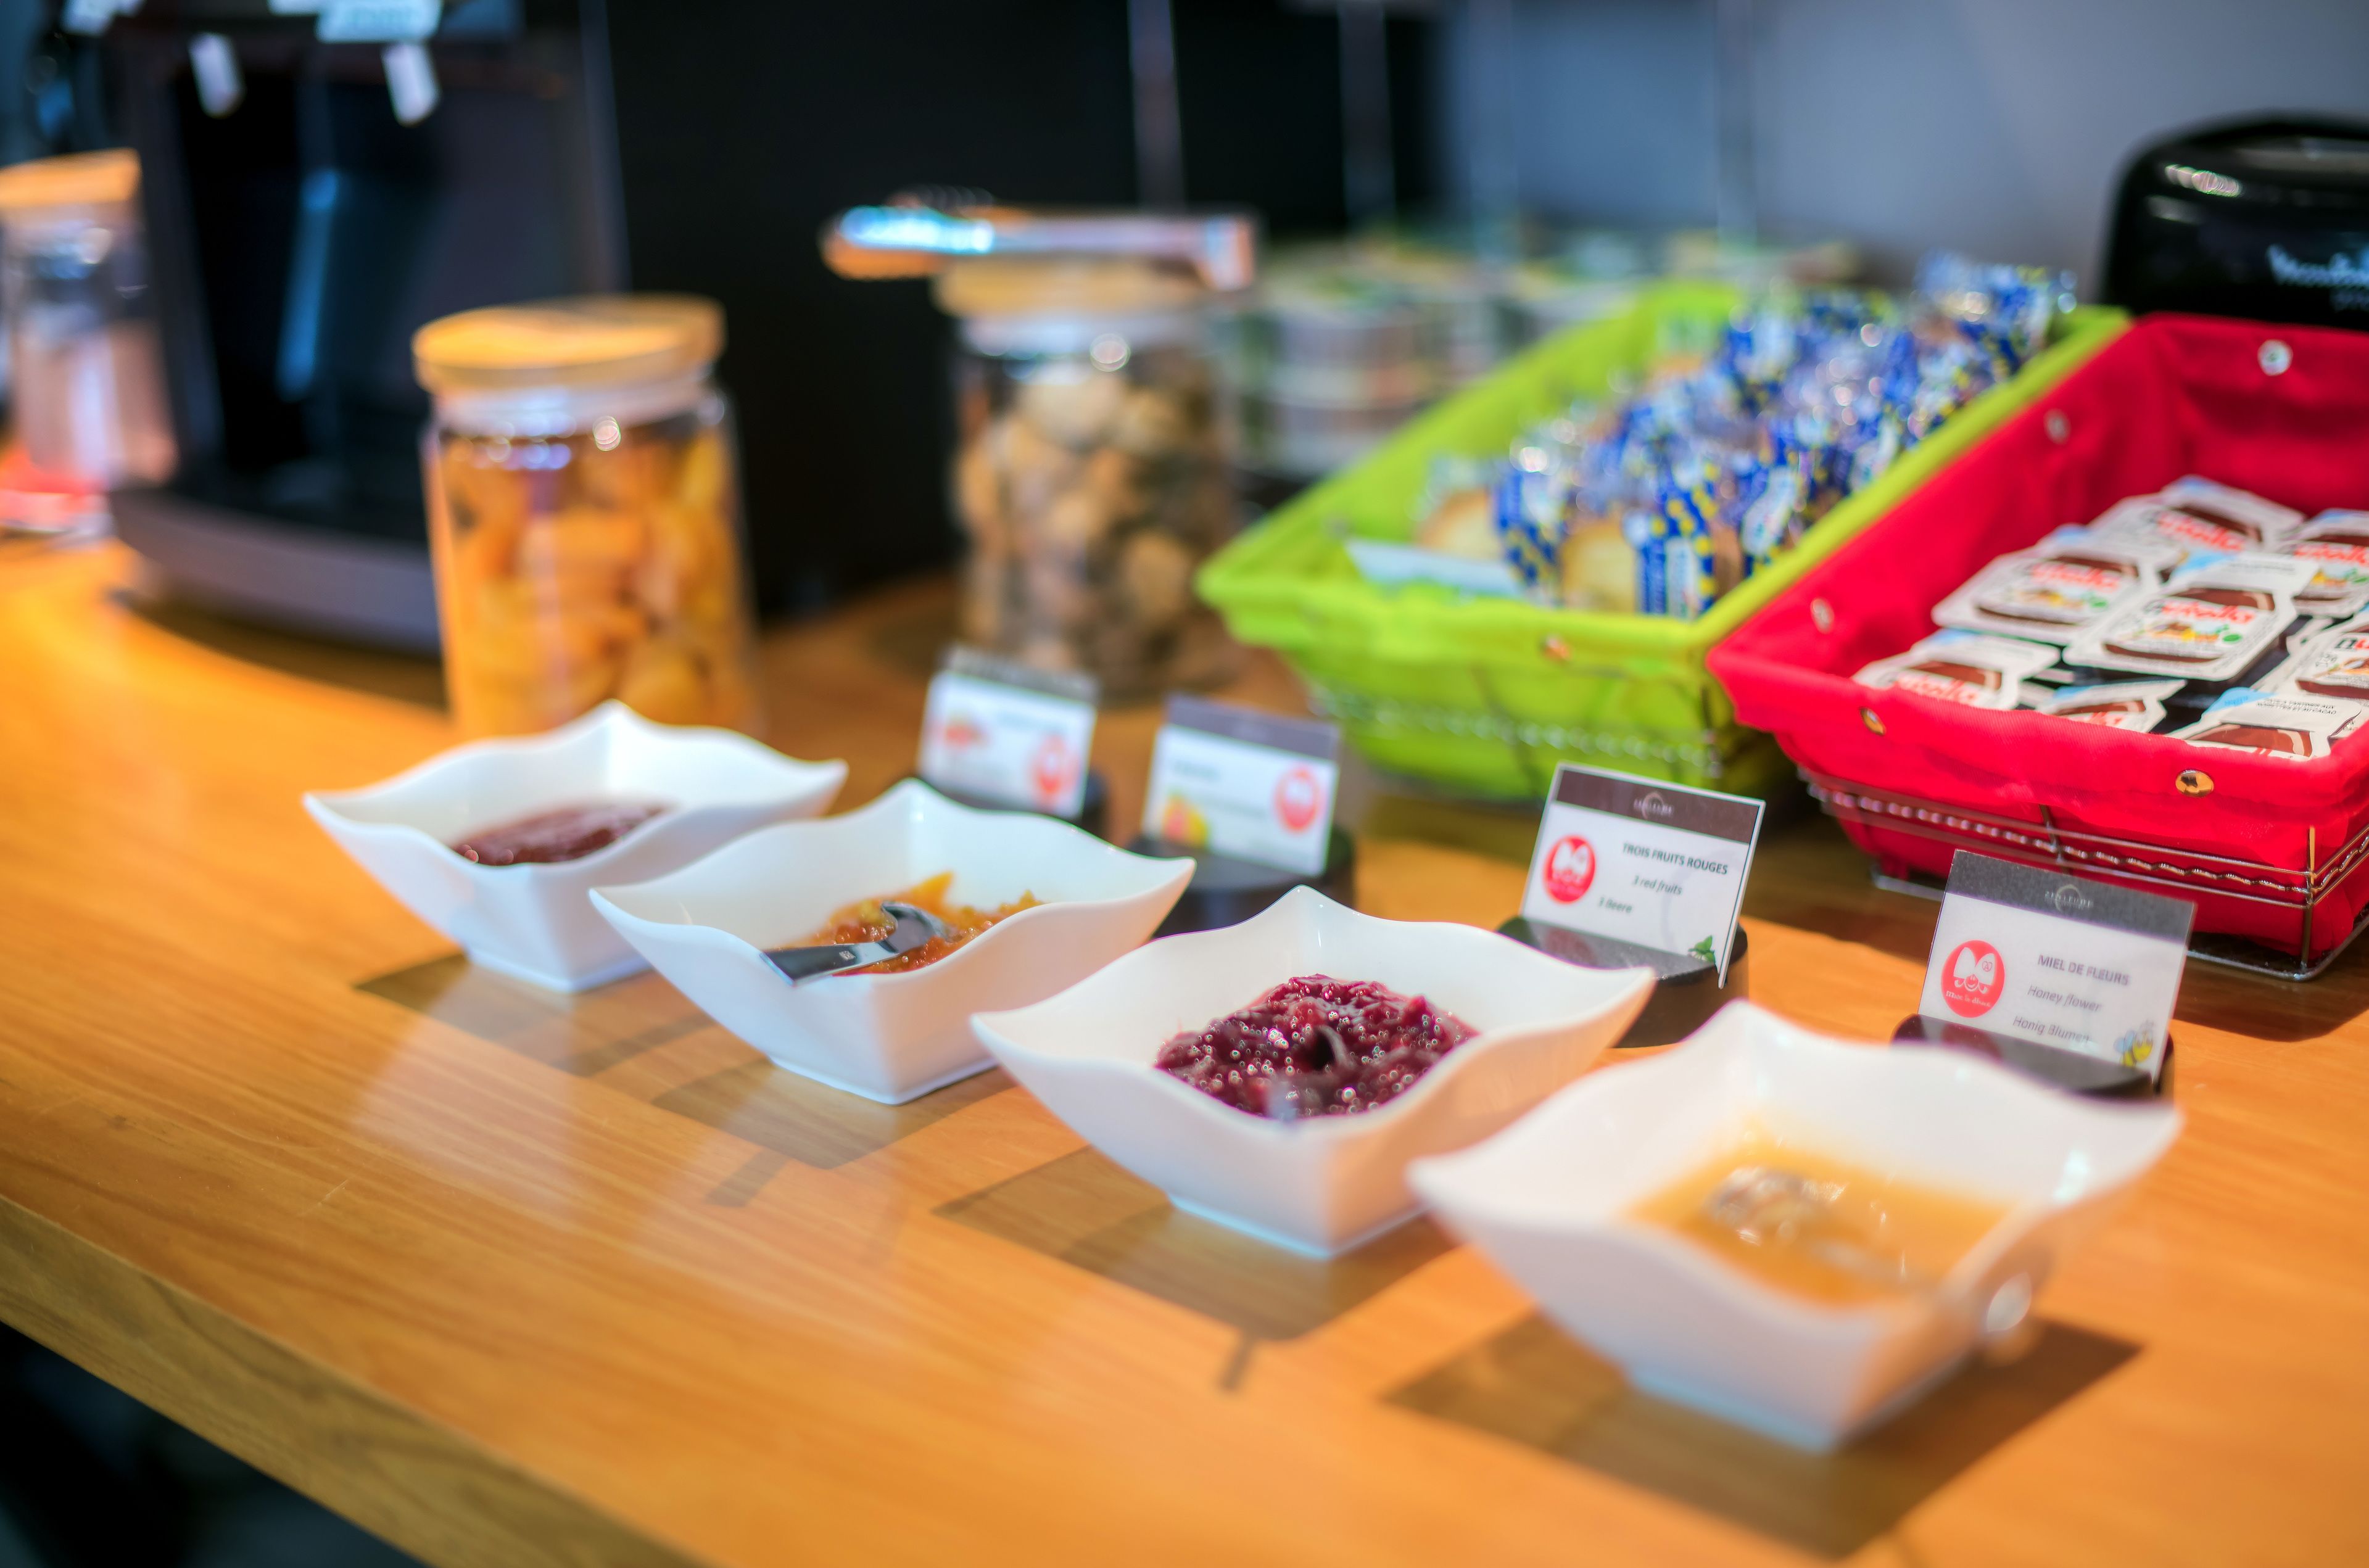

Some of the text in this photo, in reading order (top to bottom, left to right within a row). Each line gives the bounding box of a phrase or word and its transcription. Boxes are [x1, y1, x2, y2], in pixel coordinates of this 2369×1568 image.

[1623, 843, 1729, 875] TROIS FRUITS ROUGES
[1632, 875, 1683, 895] 3 red fruits
[1605, 898, 1633, 914] Beere
[2038, 954, 2130, 986] MIEL DE FLEURS
[2027, 984, 2102, 1012] Honey flower
[2012, 1015, 2090, 1044] Honig Blumen
